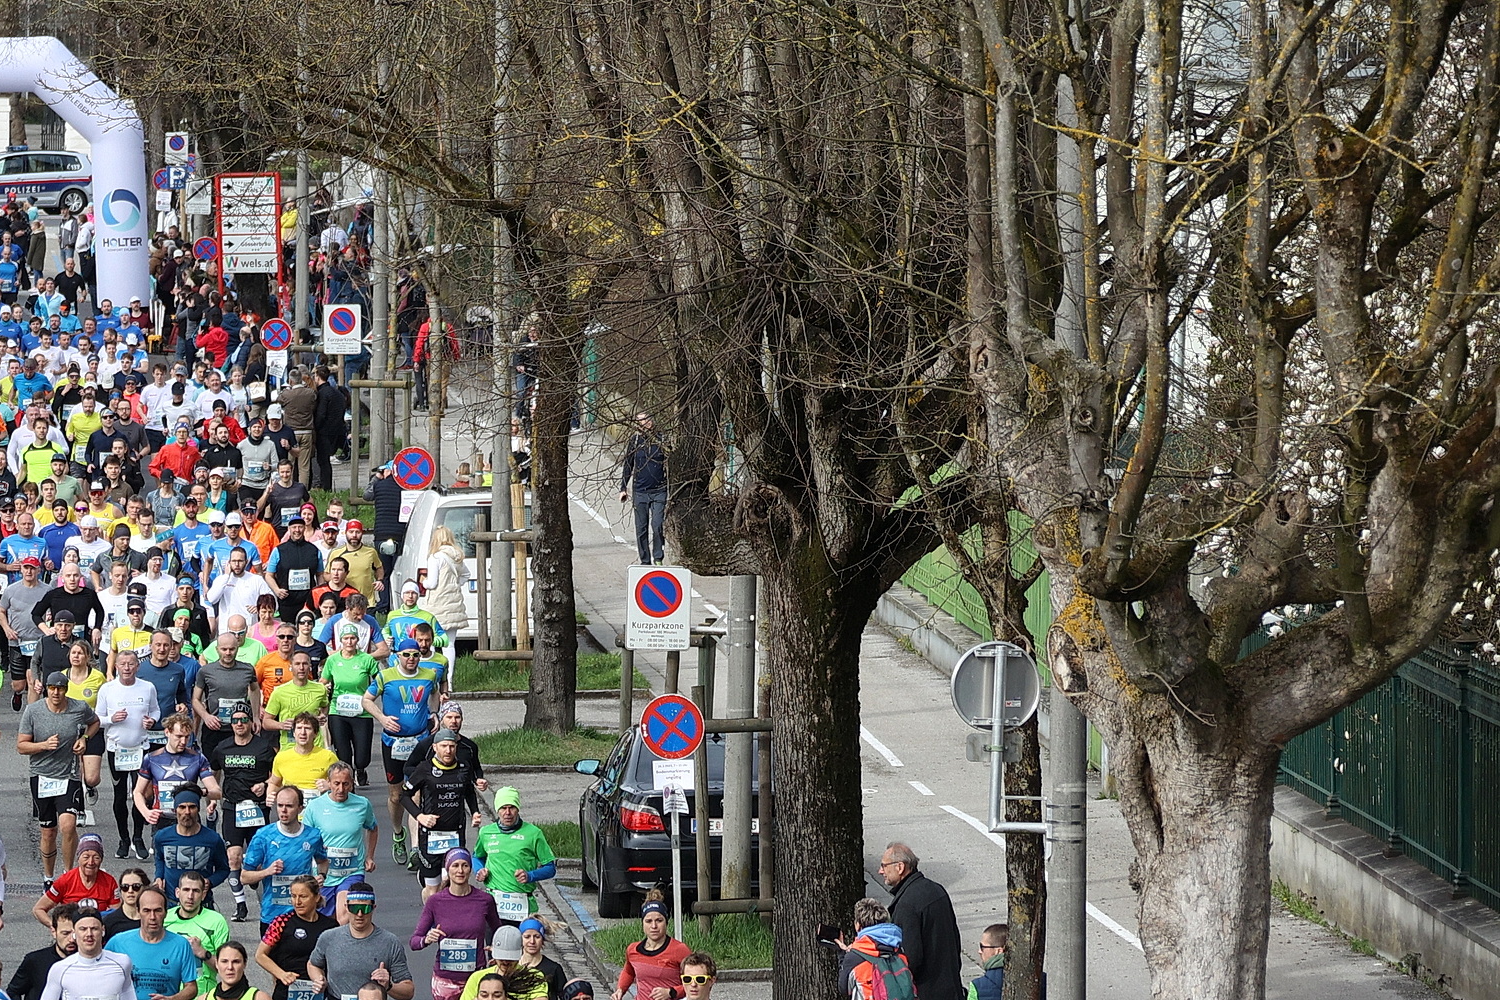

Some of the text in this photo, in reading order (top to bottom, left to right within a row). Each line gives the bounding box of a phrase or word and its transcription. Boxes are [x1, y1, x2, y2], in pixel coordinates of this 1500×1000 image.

[4, 186, 41, 194] POLIZEI
[102, 237, 143, 248] HOLTER
[241, 259, 274, 268] wels.at
[291, 576, 308, 584] 2084
[631, 621, 684, 631] Kurzparkzone
[340, 701, 360, 711] 2248
[395, 745, 415, 753] 2085
[118, 754, 140, 763] 2215
[224, 758, 256, 766] CHICAGO
[43, 780, 64, 789] 2217
[241, 808, 257, 818] 308
[437, 841, 449, 849] 24
[334, 858, 351, 867] 370
[498, 901, 523, 911] 2020
[448, 951, 468, 961] 289
